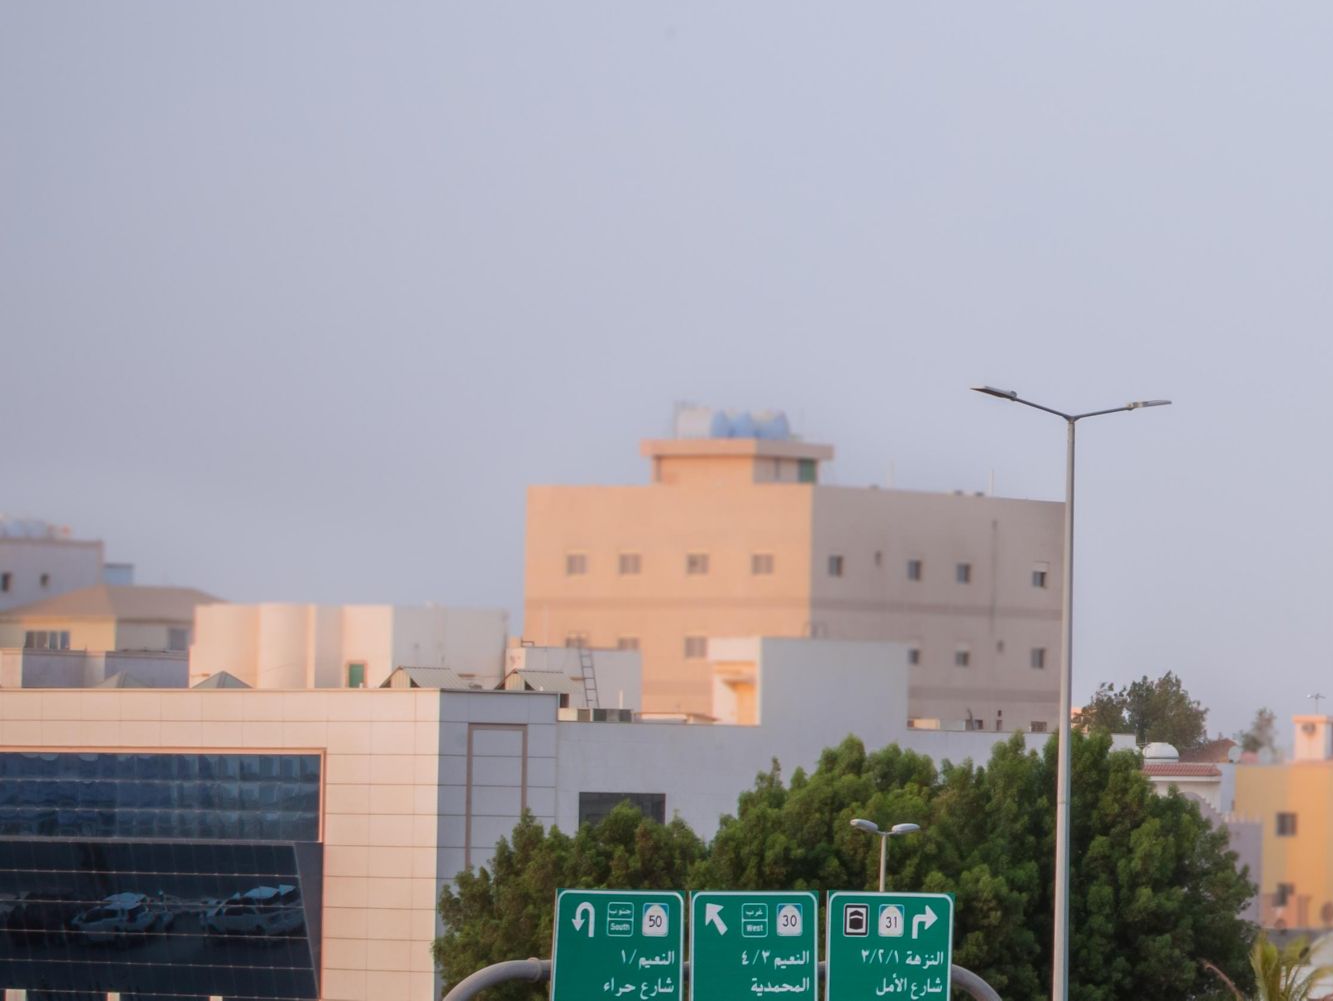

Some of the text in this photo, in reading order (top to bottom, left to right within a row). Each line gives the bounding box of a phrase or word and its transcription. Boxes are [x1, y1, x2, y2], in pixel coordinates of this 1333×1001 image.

[745, 907, 764, 917] غرب
[609, 922, 631, 931] South
[648, 915, 663, 928] 50
[745, 923, 764, 932] West
[782, 914, 798, 928] 30
[885, 916, 898, 929] 31
[905, 951, 944, 969] النزهة
[602, 977, 675, 1000] شارع حراء
[750, 976, 810, 997] المحمدية
[875, 972, 943, 1000] شارع الأمل
